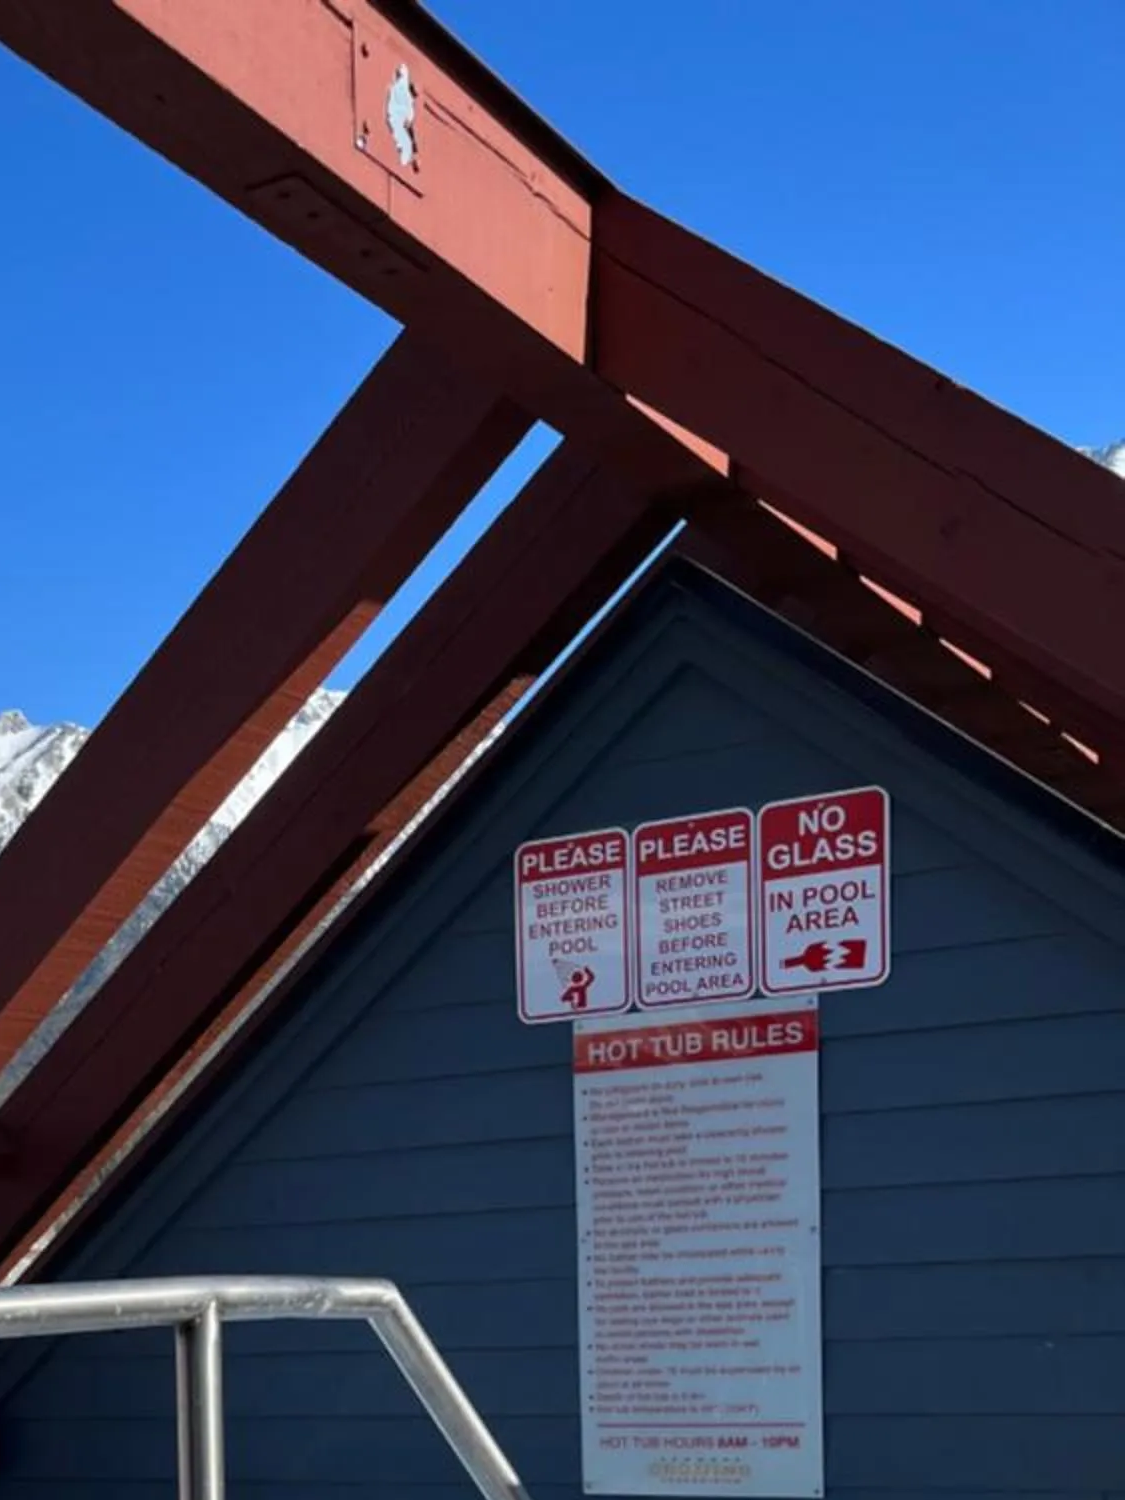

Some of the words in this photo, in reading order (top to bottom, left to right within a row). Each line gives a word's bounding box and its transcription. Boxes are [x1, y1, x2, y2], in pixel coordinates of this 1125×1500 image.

[798, 805, 845, 836] NO
[639, 825, 746, 862] PLEASE
[767, 830, 877, 870] GLASS
[522, 841, 622, 875] PLEASE
[533, 874, 611, 899] SHOWER
[656, 870, 728, 893] REMOVE
[536, 897, 609, 918] BEFORE
[659, 892, 724, 913] STREET
[769, 891, 794, 912] IN
[802, 881, 875, 908] POOL
[529, 914, 618, 939] ENTERING
[663, 914, 722, 934] SHOES
[786, 907, 860, 933] AREA
[548, 938, 599, 955] POOL
[659, 933, 728, 954] BEFORE
[651, 953, 737, 976] ENTERING
[645, 978, 691, 997] POOL
[696, 972, 744, 991] AREA
[588, 1038, 642, 1064] HOT
[650, 1032, 703, 1057] TUB
[711, 1021, 803, 1051] RULES
[599, 1438, 625, 1449] HOT
[664, 1437, 714, 1448] HOURS
